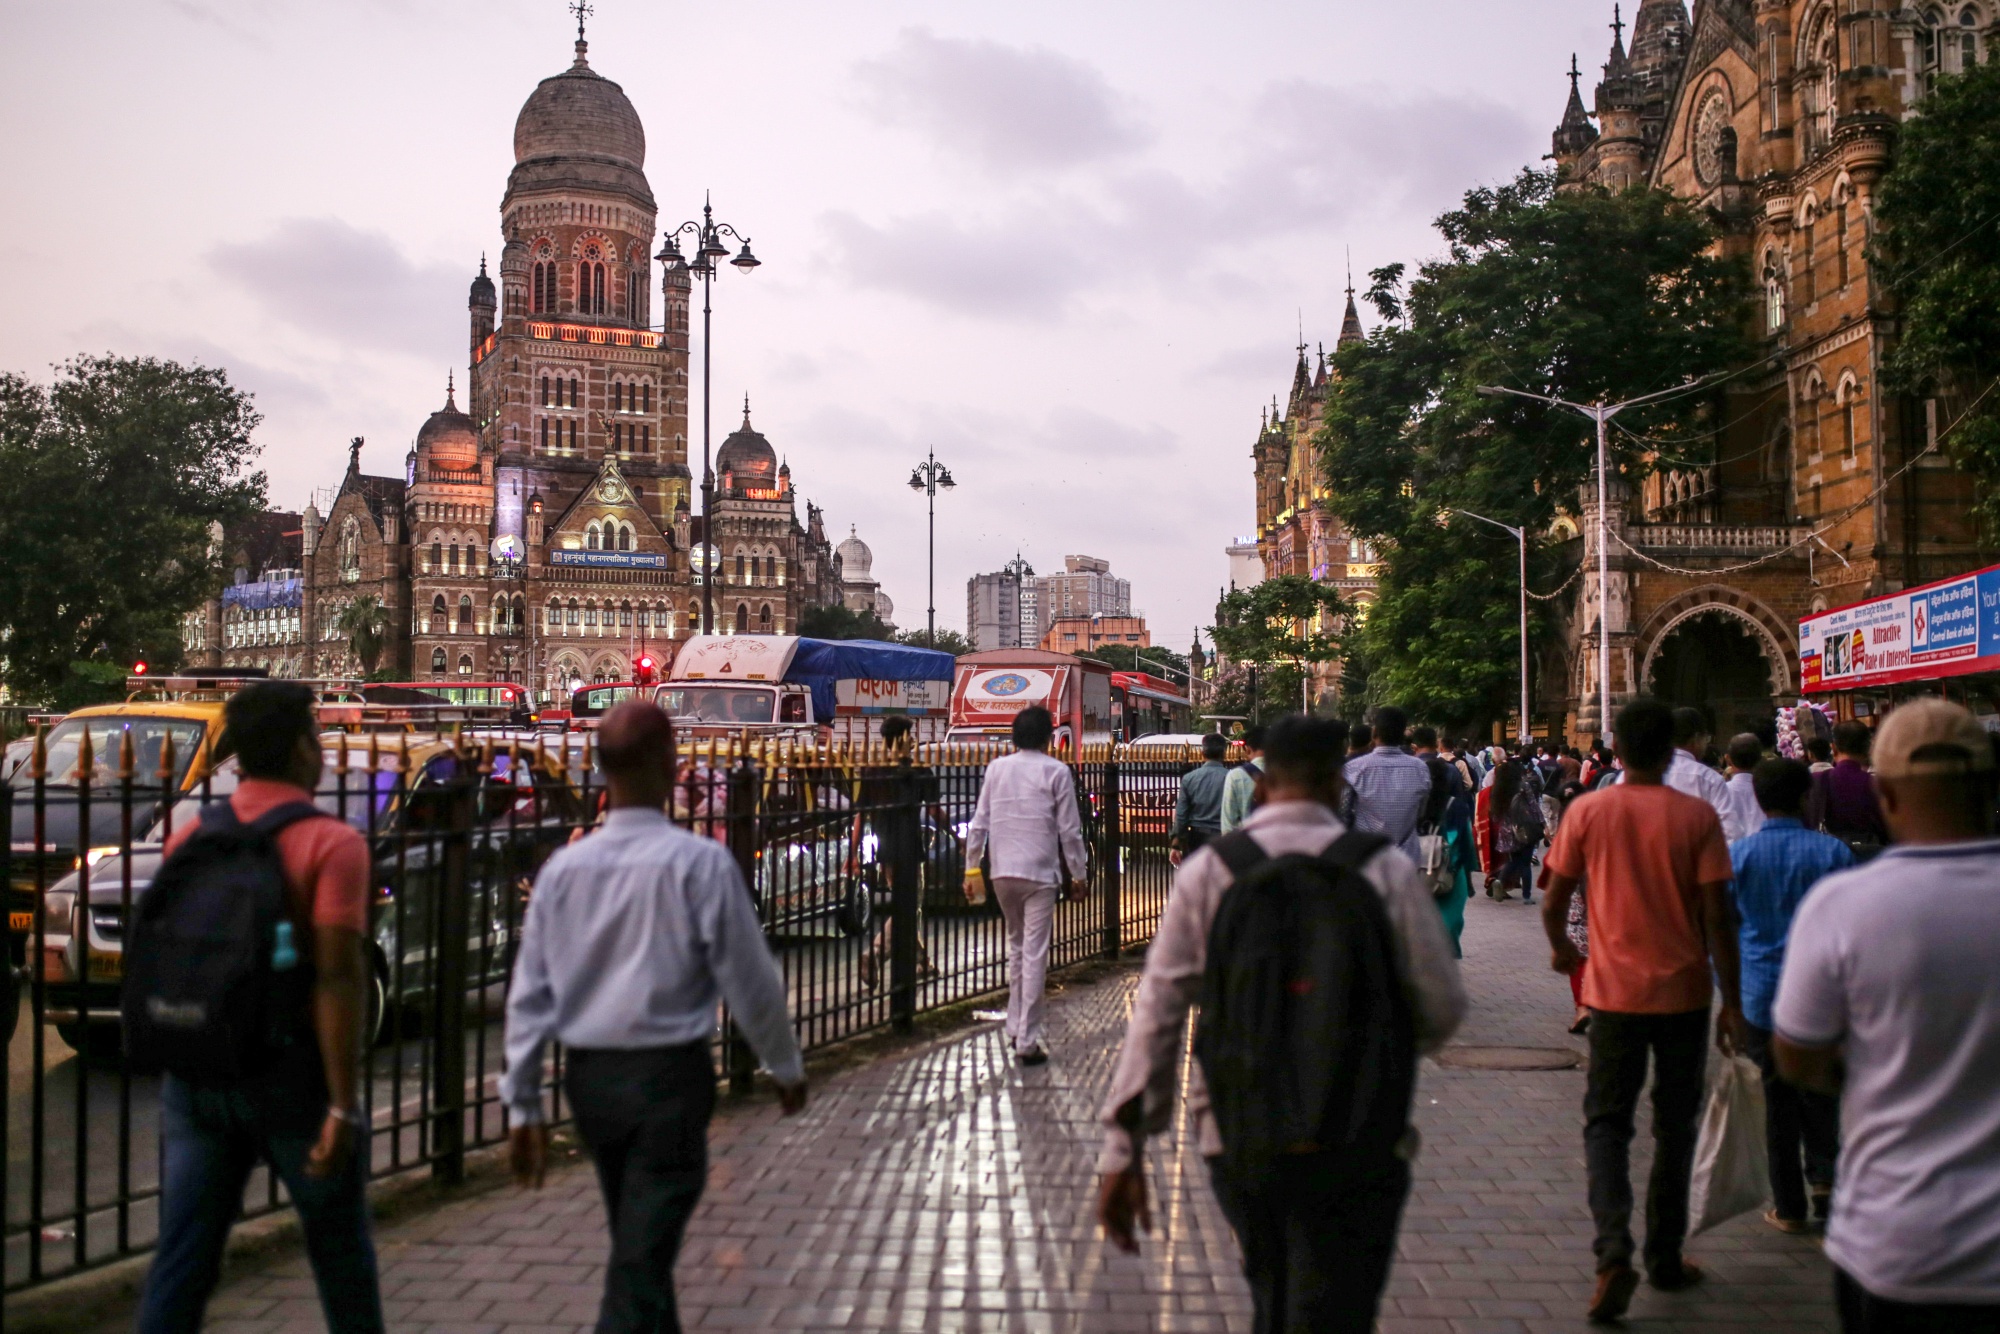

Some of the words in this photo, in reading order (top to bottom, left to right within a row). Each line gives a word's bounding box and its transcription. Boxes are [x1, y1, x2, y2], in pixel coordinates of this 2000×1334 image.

[587, 554, 629, 563] महानगरपालिका
[631, 556, 654, 565] मुख्यालय
[1982, 591, 1997, 608] Your
[1873, 623, 1901, 645] Attractive
[1931, 629, 1945, 643] Central
[1946, 626, 1957, 640] Bank
[1957, 625, 1963, 638] of
[1963, 624, 1975, 636] India
[1865, 652, 1877, 670] Rate
[1878, 650, 1885, 668] of
[1886, 647, 1910, 668] Interest
